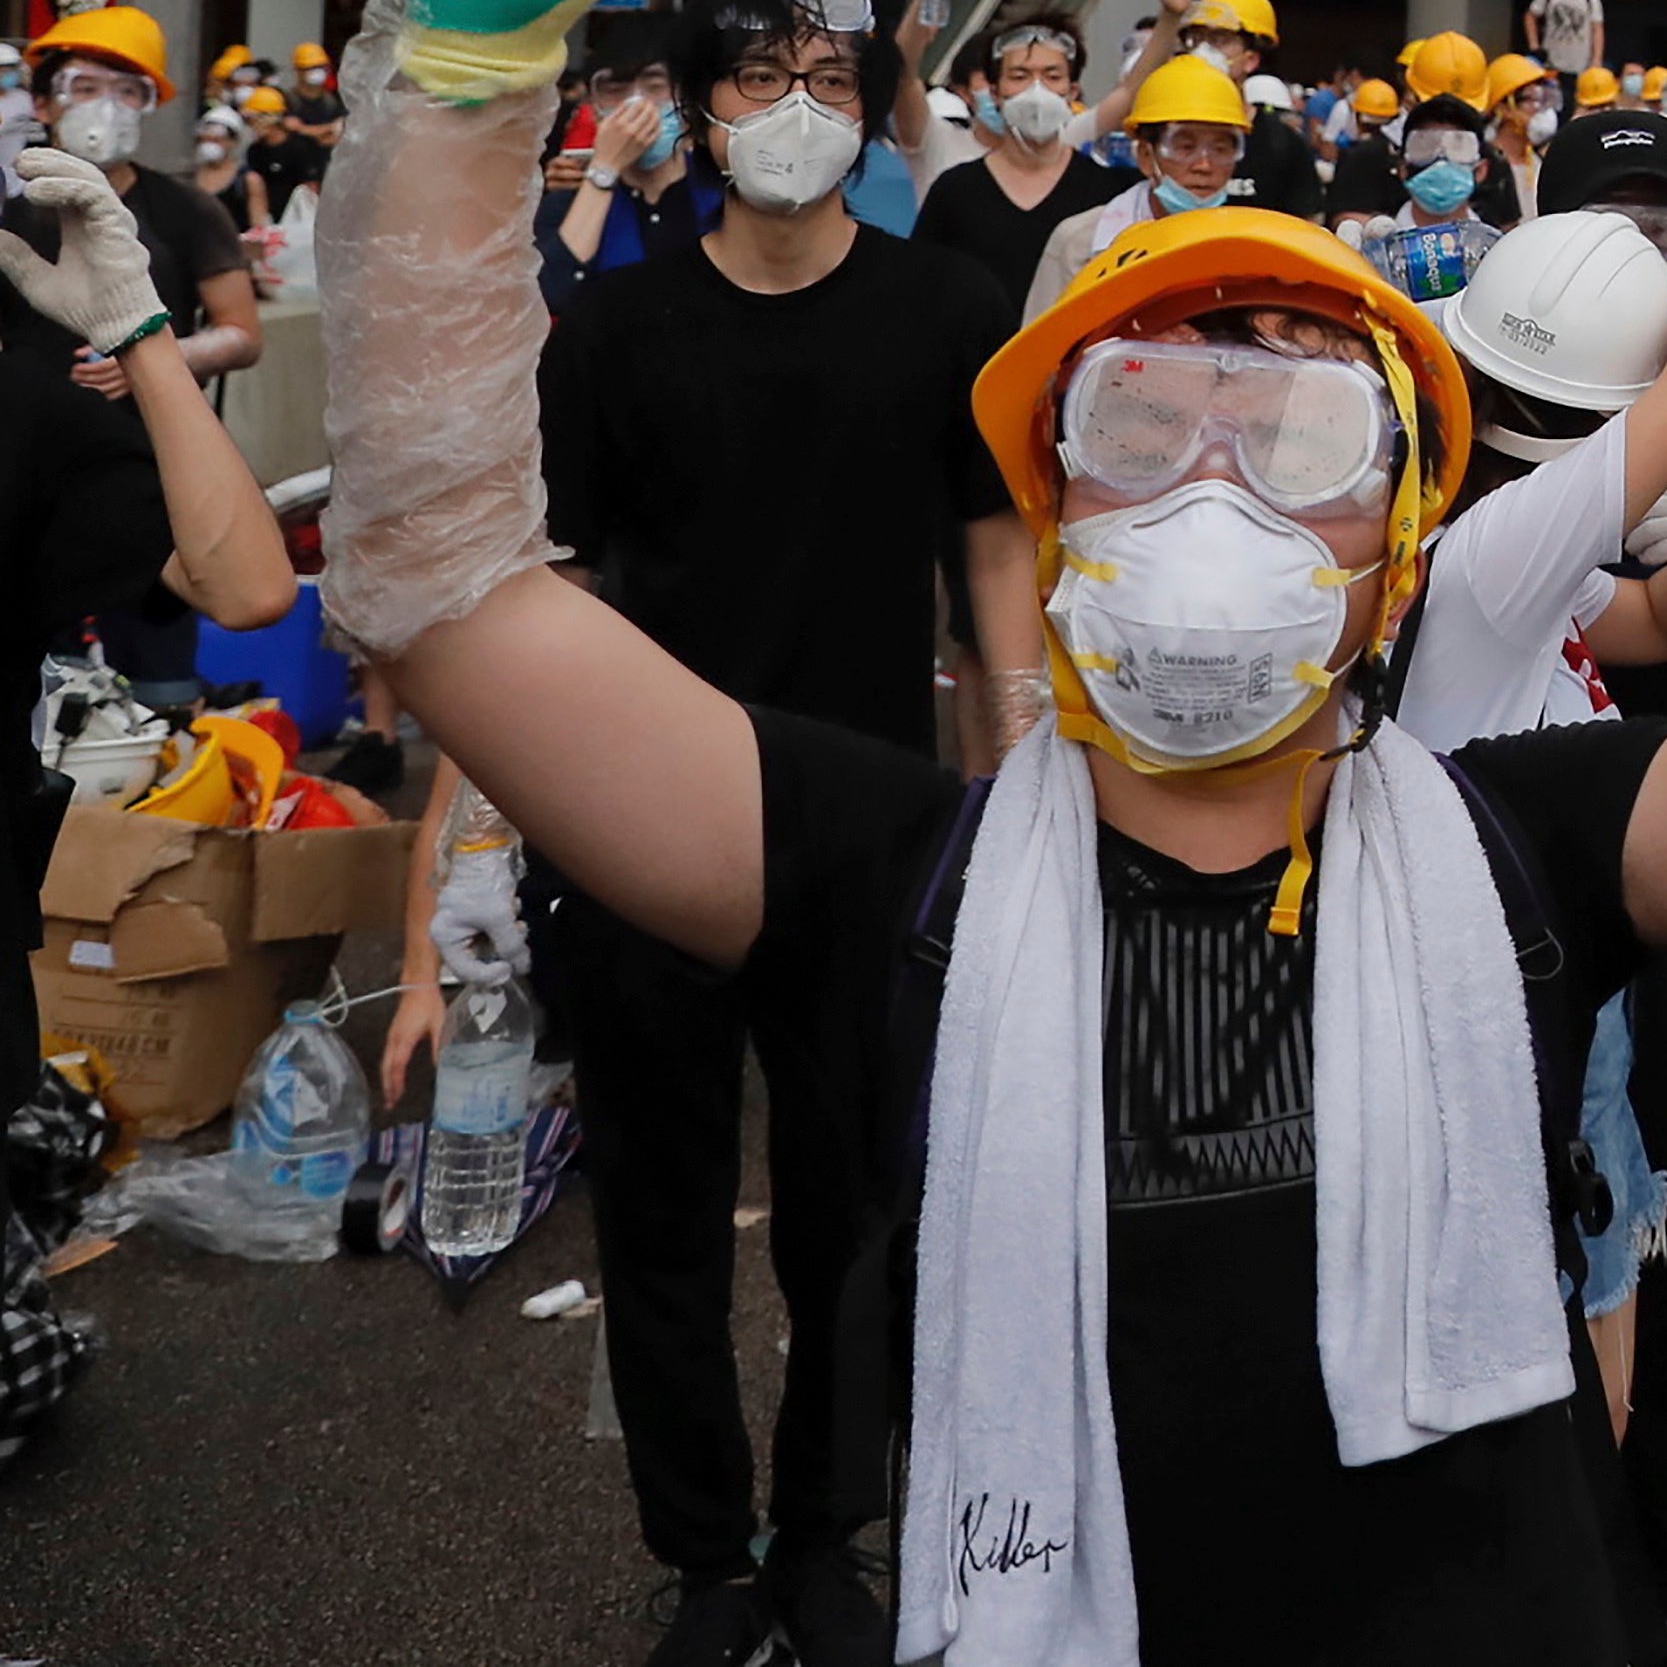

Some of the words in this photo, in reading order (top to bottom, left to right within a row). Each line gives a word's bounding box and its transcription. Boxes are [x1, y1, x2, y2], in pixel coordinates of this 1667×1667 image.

[1422, 232, 1443, 292] Bonaqua
[1121, 359, 1145, 373] 3M
[1162, 653, 1238, 667] WARNING
[1152, 707, 1184, 724] 3M
[958, 1491, 1068, 1598] Killer
